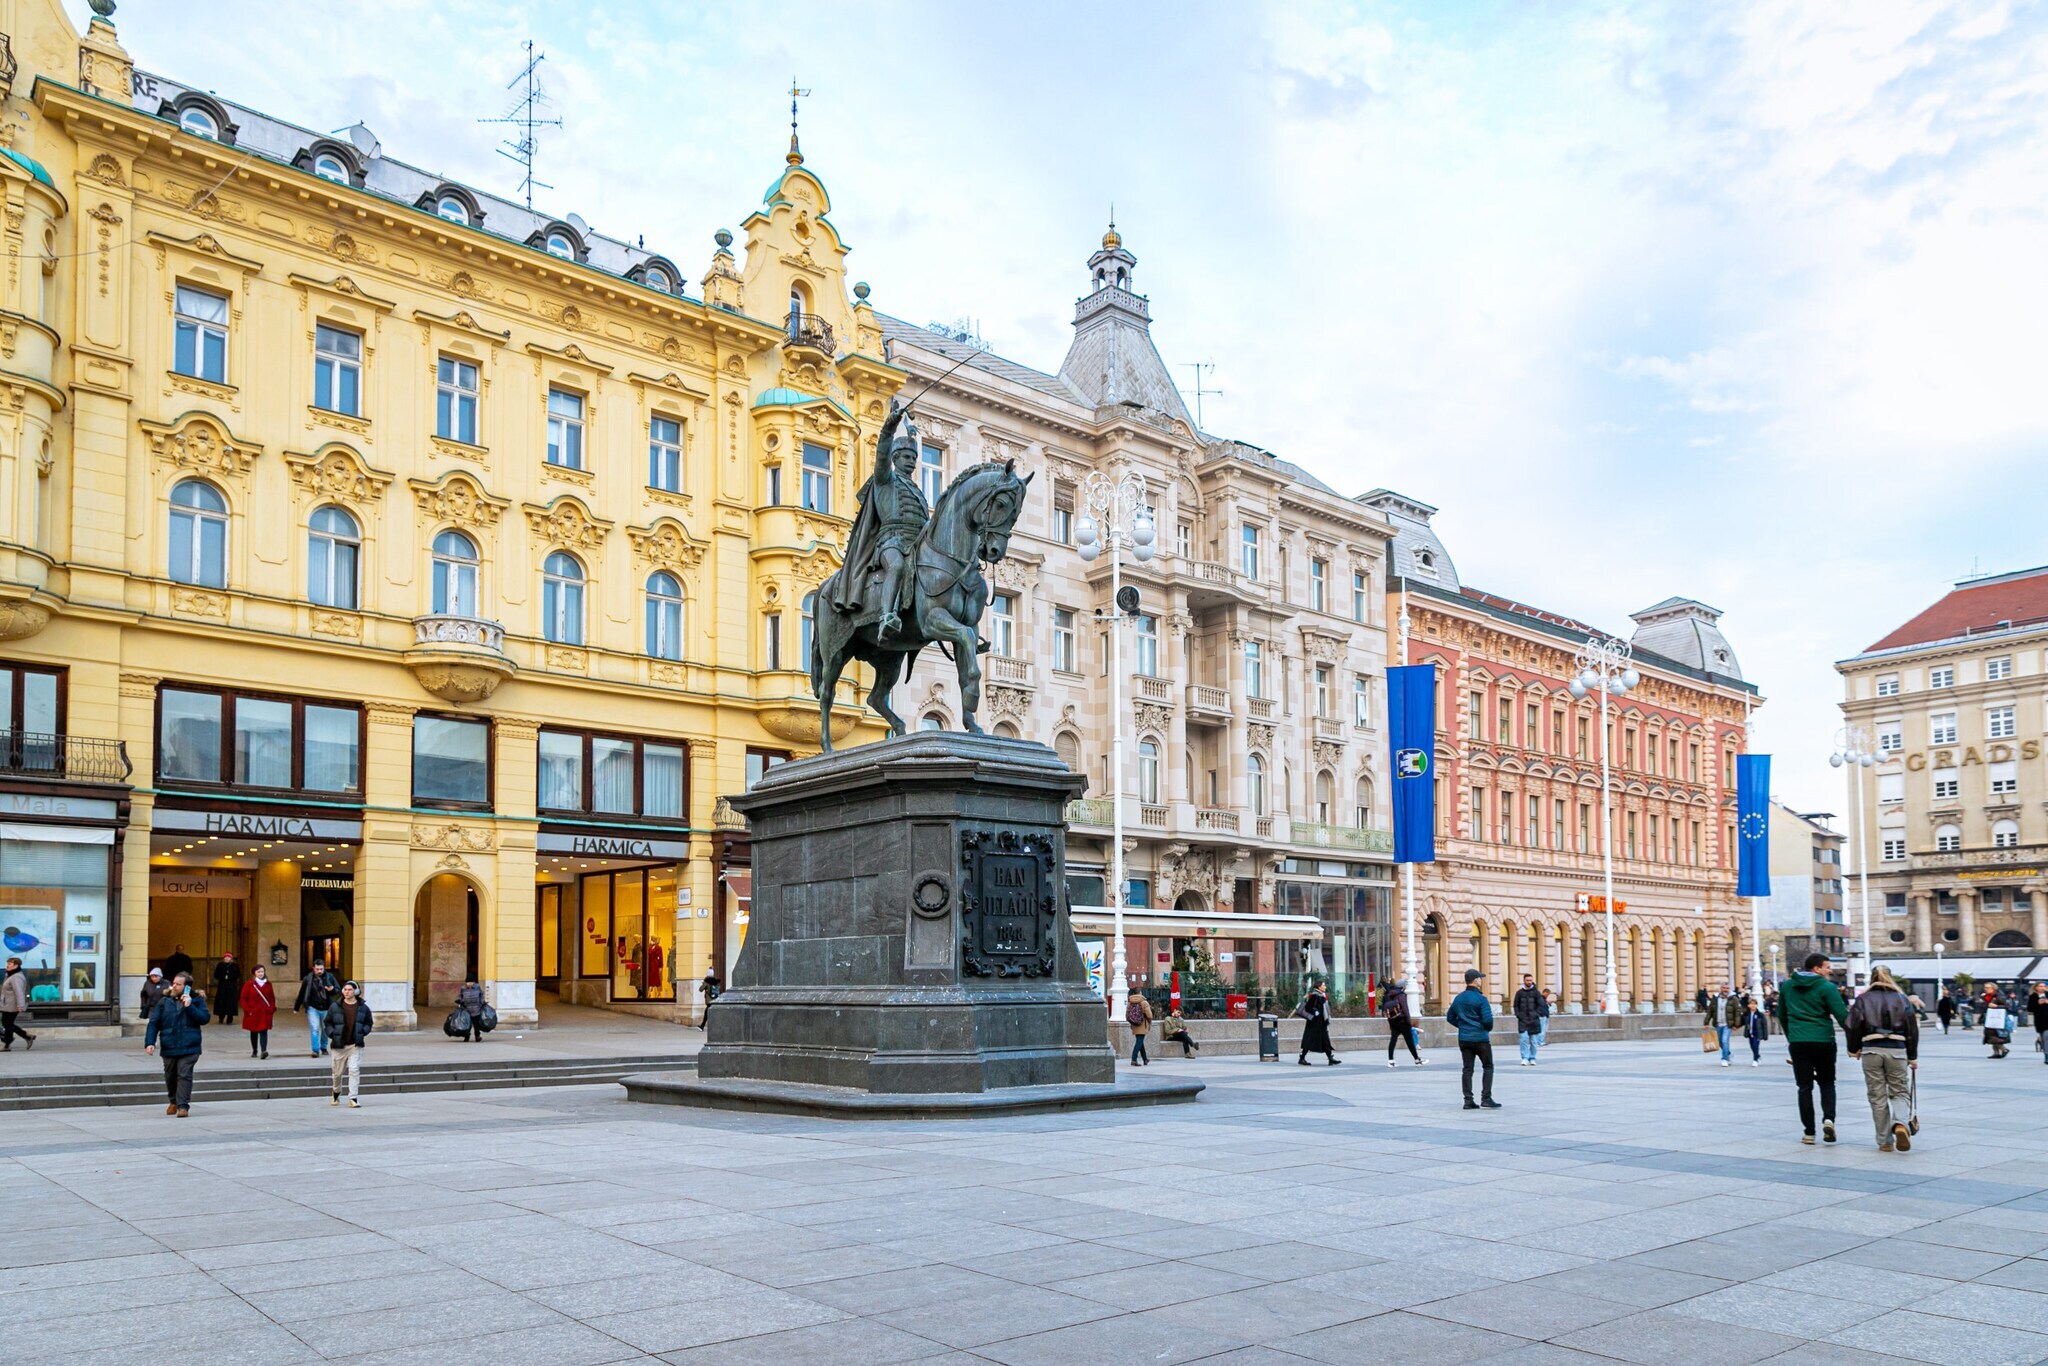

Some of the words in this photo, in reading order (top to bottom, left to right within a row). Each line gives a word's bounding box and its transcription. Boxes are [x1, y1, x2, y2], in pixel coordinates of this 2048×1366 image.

[12, 795, 69, 815] Mala
[205, 813, 315, 837] HARMICA
[573, 837, 653, 857] HARMICA
[994, 867, 1025, 887] BAN
[1589, 895, 1628, 914] Müler
